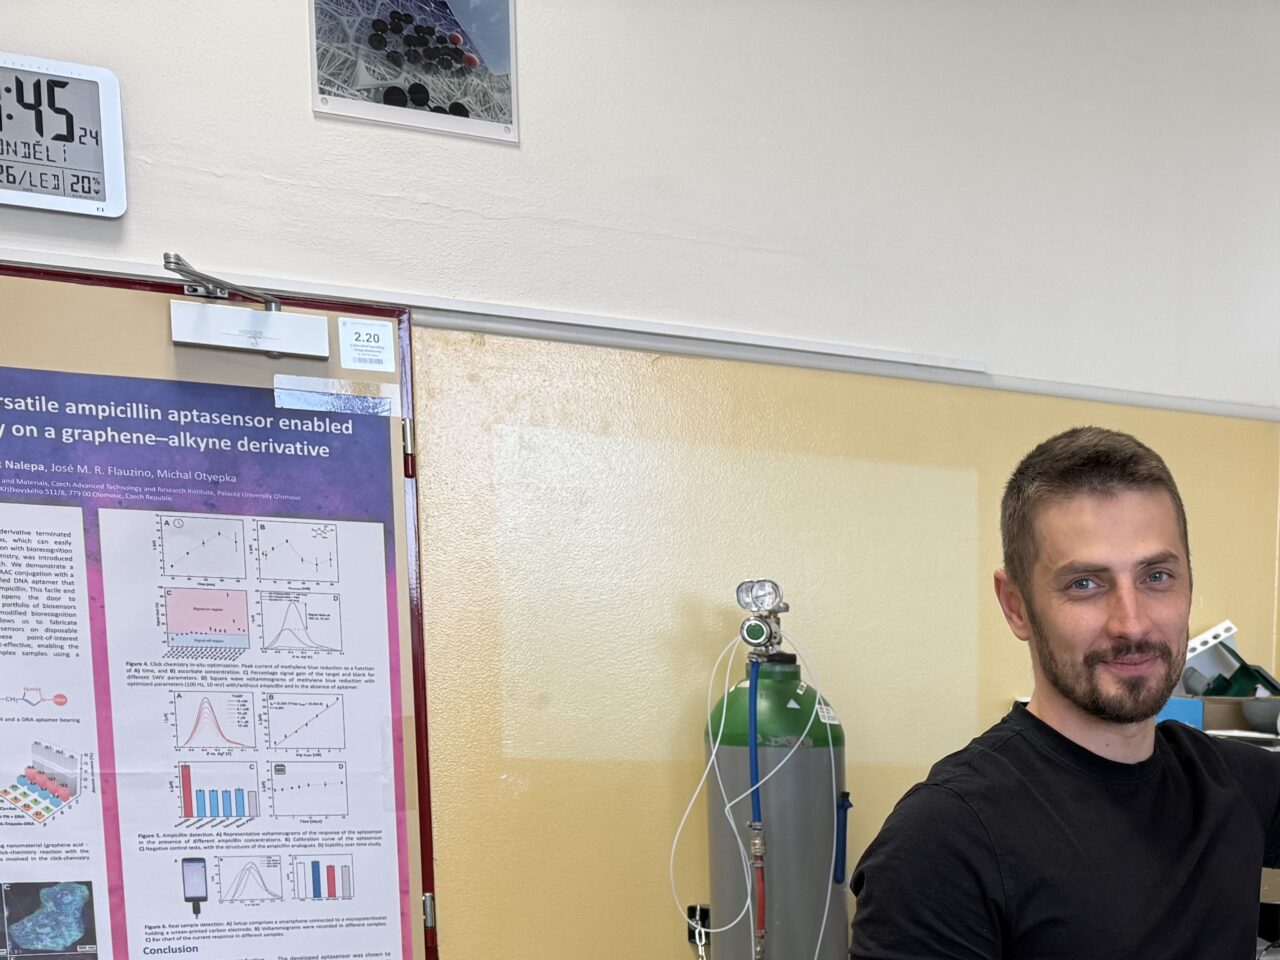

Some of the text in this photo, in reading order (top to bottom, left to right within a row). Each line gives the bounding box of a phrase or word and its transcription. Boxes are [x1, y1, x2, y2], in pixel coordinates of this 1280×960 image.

[0, 75, 99, 146] :45 24
[354, 331, 380, 343] 2.20
[65, 397, 161, 424] ampicillin
[167, 405, 273, 432] aptasensor
[279, 413, 352, 434] enabled
[11, 425, 37, 438] on
[44, 427, 55, 439] a
[61, 424, 231, 455] graphene–alkyne
[237, 436, 329, 457] derivative
[5, 460, 236, 484] Nalepa, José M. R. Flauzino, Michal Otyepka
[143, 945, 199, 955] Conclusion
